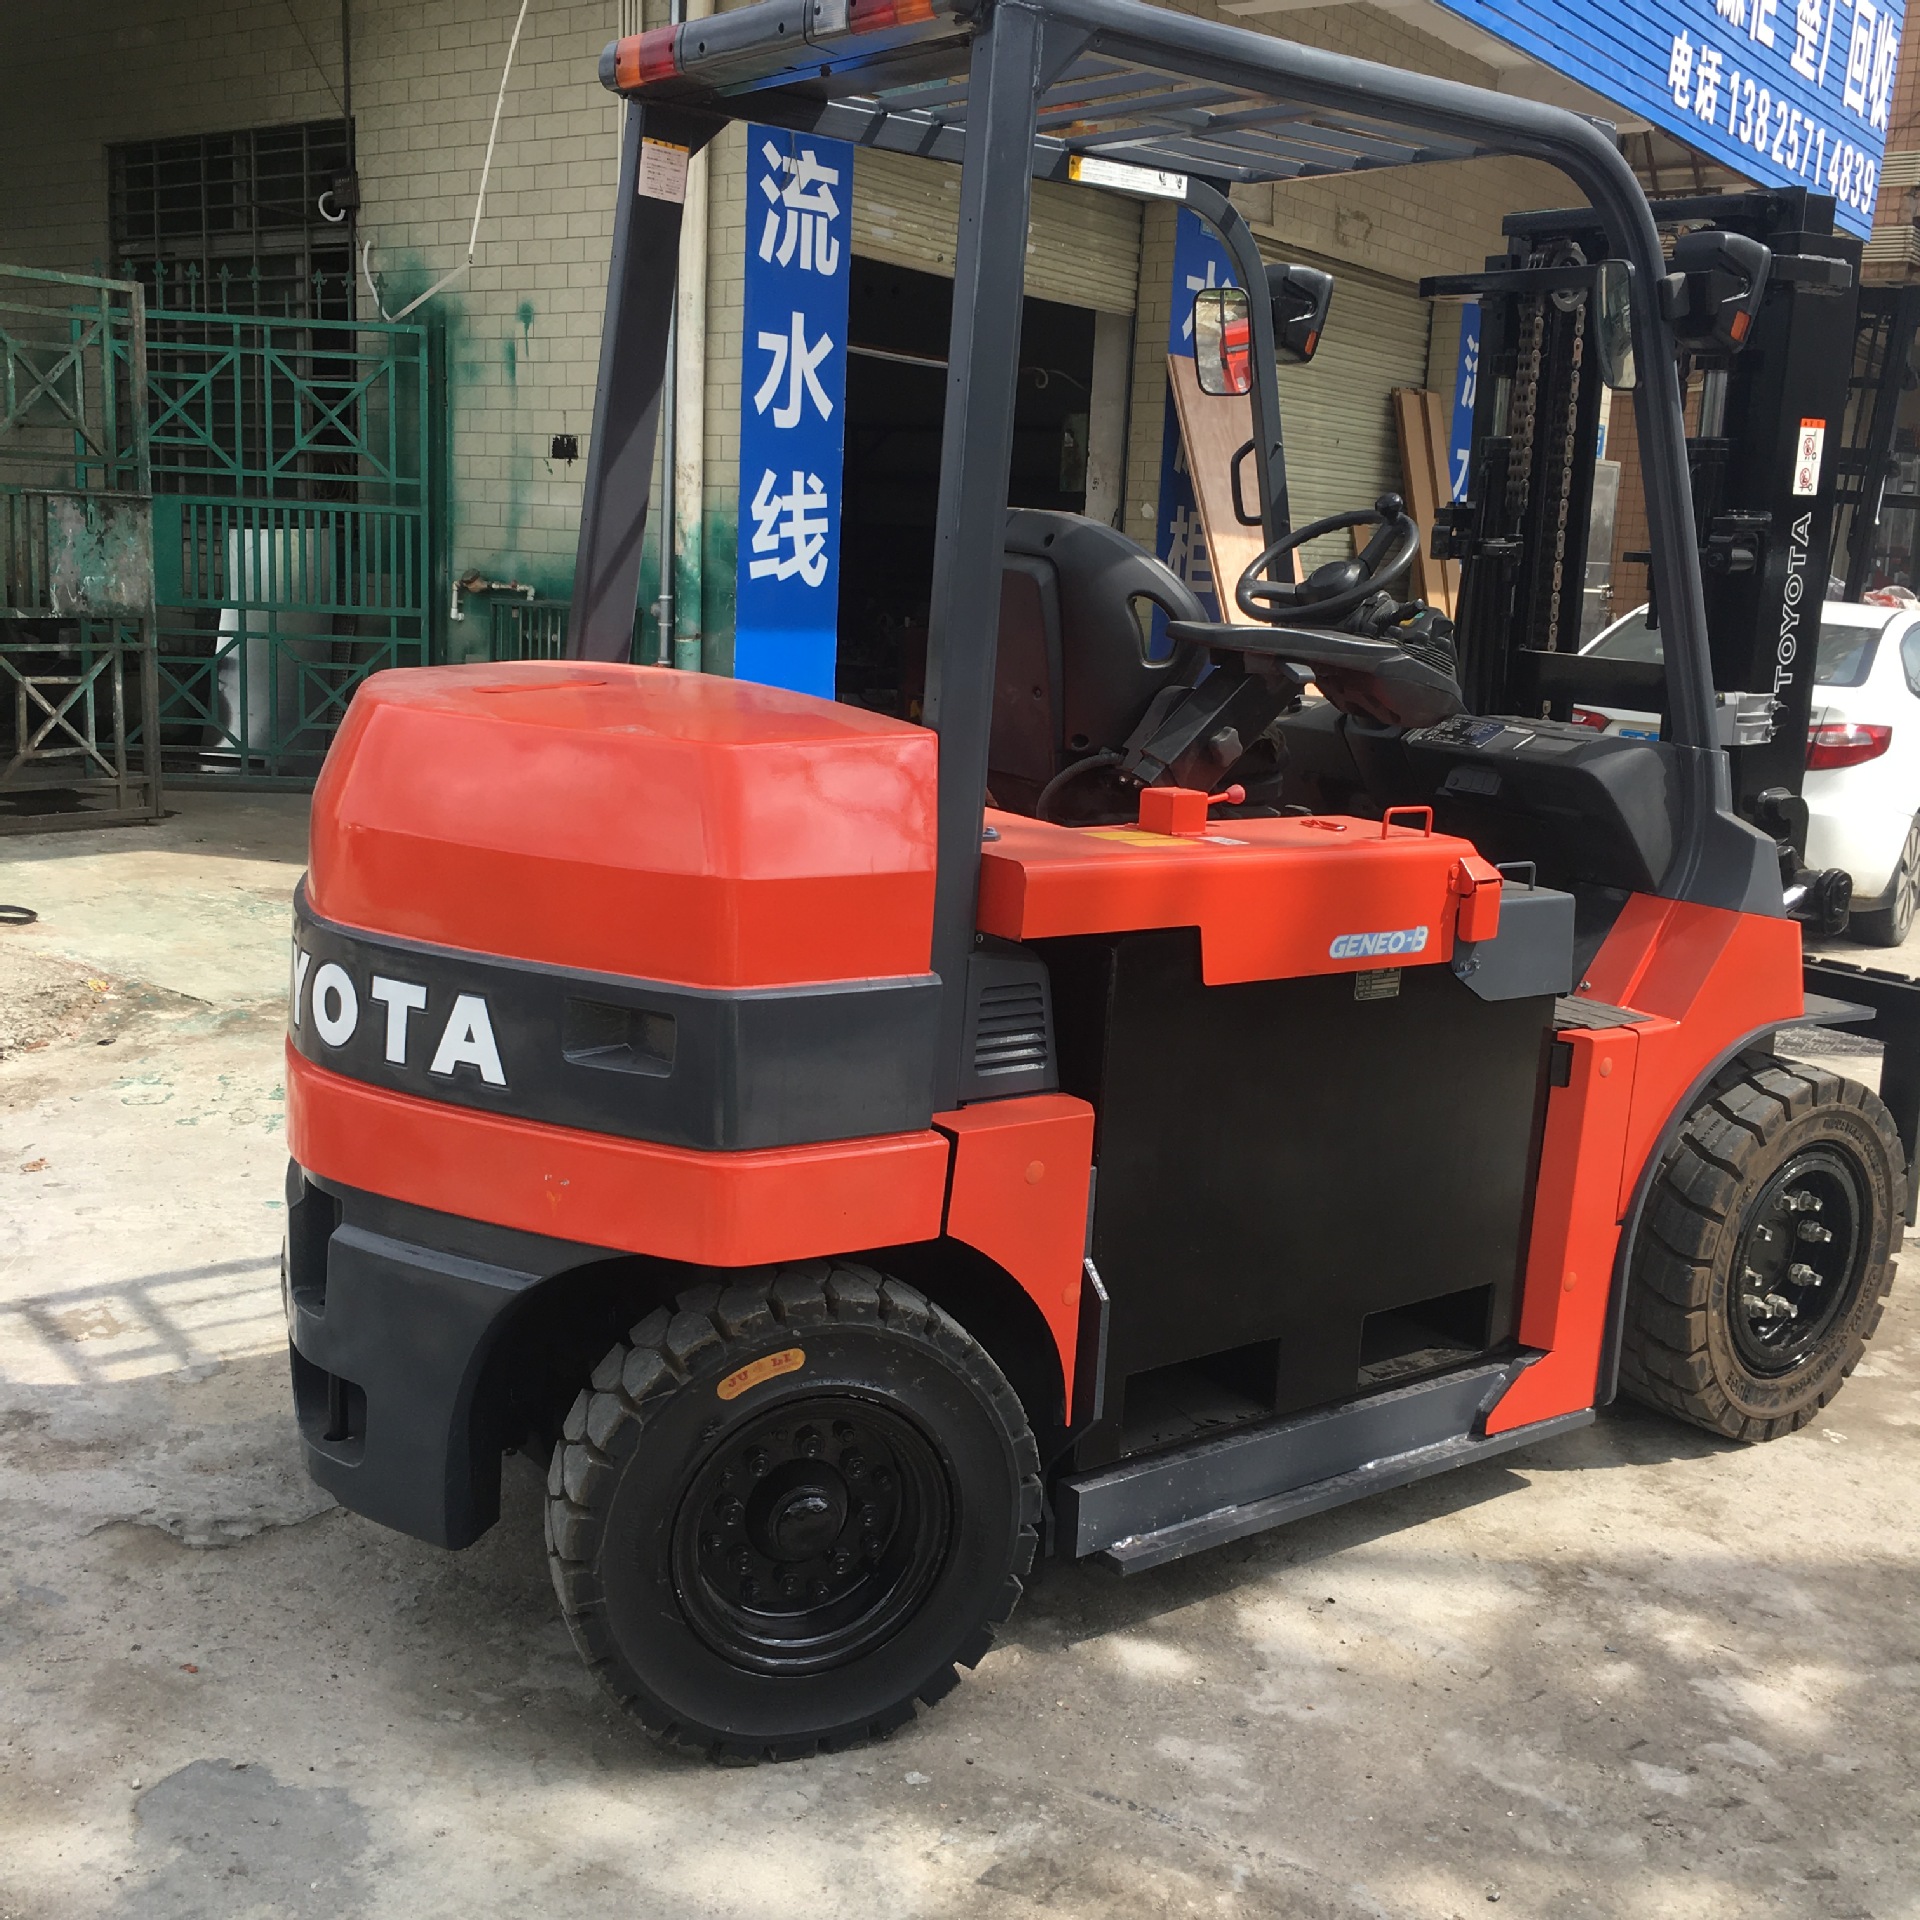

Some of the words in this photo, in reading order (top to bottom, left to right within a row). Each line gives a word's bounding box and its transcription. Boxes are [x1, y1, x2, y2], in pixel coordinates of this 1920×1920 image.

[1667, 29, 1723, 126] 电话
[748, 139, 841, 589] 流水线
[1773, 511, 1813, 694] TOYOTA
[1328, 925, 1430, 959] GENEO-B
